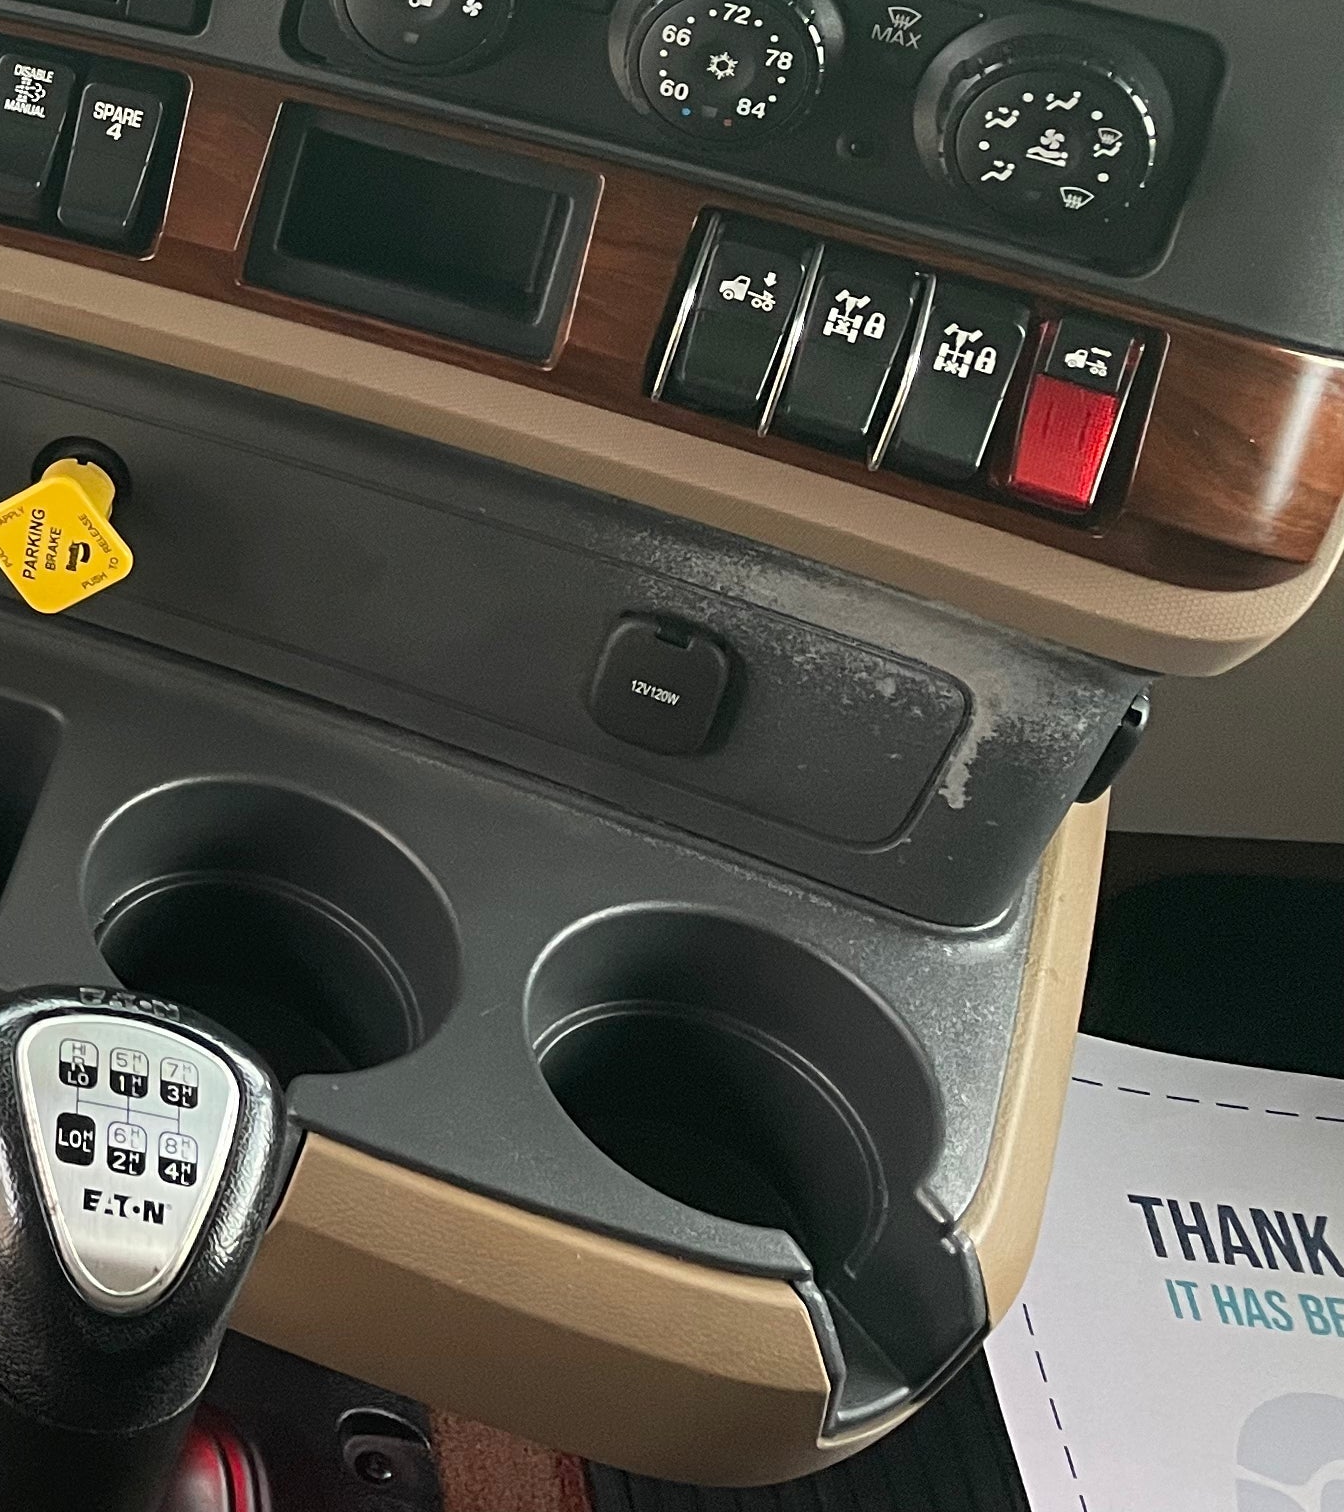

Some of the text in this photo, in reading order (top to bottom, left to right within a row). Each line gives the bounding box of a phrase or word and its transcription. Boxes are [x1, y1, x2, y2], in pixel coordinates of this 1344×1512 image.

[723, 3, 752, 25] 72
[662, 25, 692, 46] 66
[871, 24, 922, 49] MAX
[765, 49, 793, 70] 78
[13, 63, 54, 83] DISABLE
[660, 79, 689, 101] 60
[4, 98, 46, 119] MANUAL
[93, 101, 144, 128] SPARE
[736, 98, 766, 119] 84
[105, 123, 122, 141] 4
[0, 506, 25, 526] APPLY
[22, 508, 45, 580] PARKING
[45, 527, 62, 571] BRAKE
[78, 513, 118, 589] PUSH TO RELEASE
[632, 680, 680, 705] 12V120W
[72, 1043, 86, 1055] HI
[71, 1055, 85, 1072] R
[116, 1053, 128, 1067] 5
[166, 1063, 178, 1078] 7
[67, 1072, 89, 1086] LO
[167, 1086, 180, 1101] 3
[114, 1128, 127, 1144] 6
[165, 1138, 178, 1154] 8
[112, 1152, 128, 1170] 2
[164, 1163, 179, 1180] 4
[1127, 1194, 1344, 1278] THANK
[1165, 1278, 1203, 1321] IT
[1210, 1284, 1295, 1332] HAS
